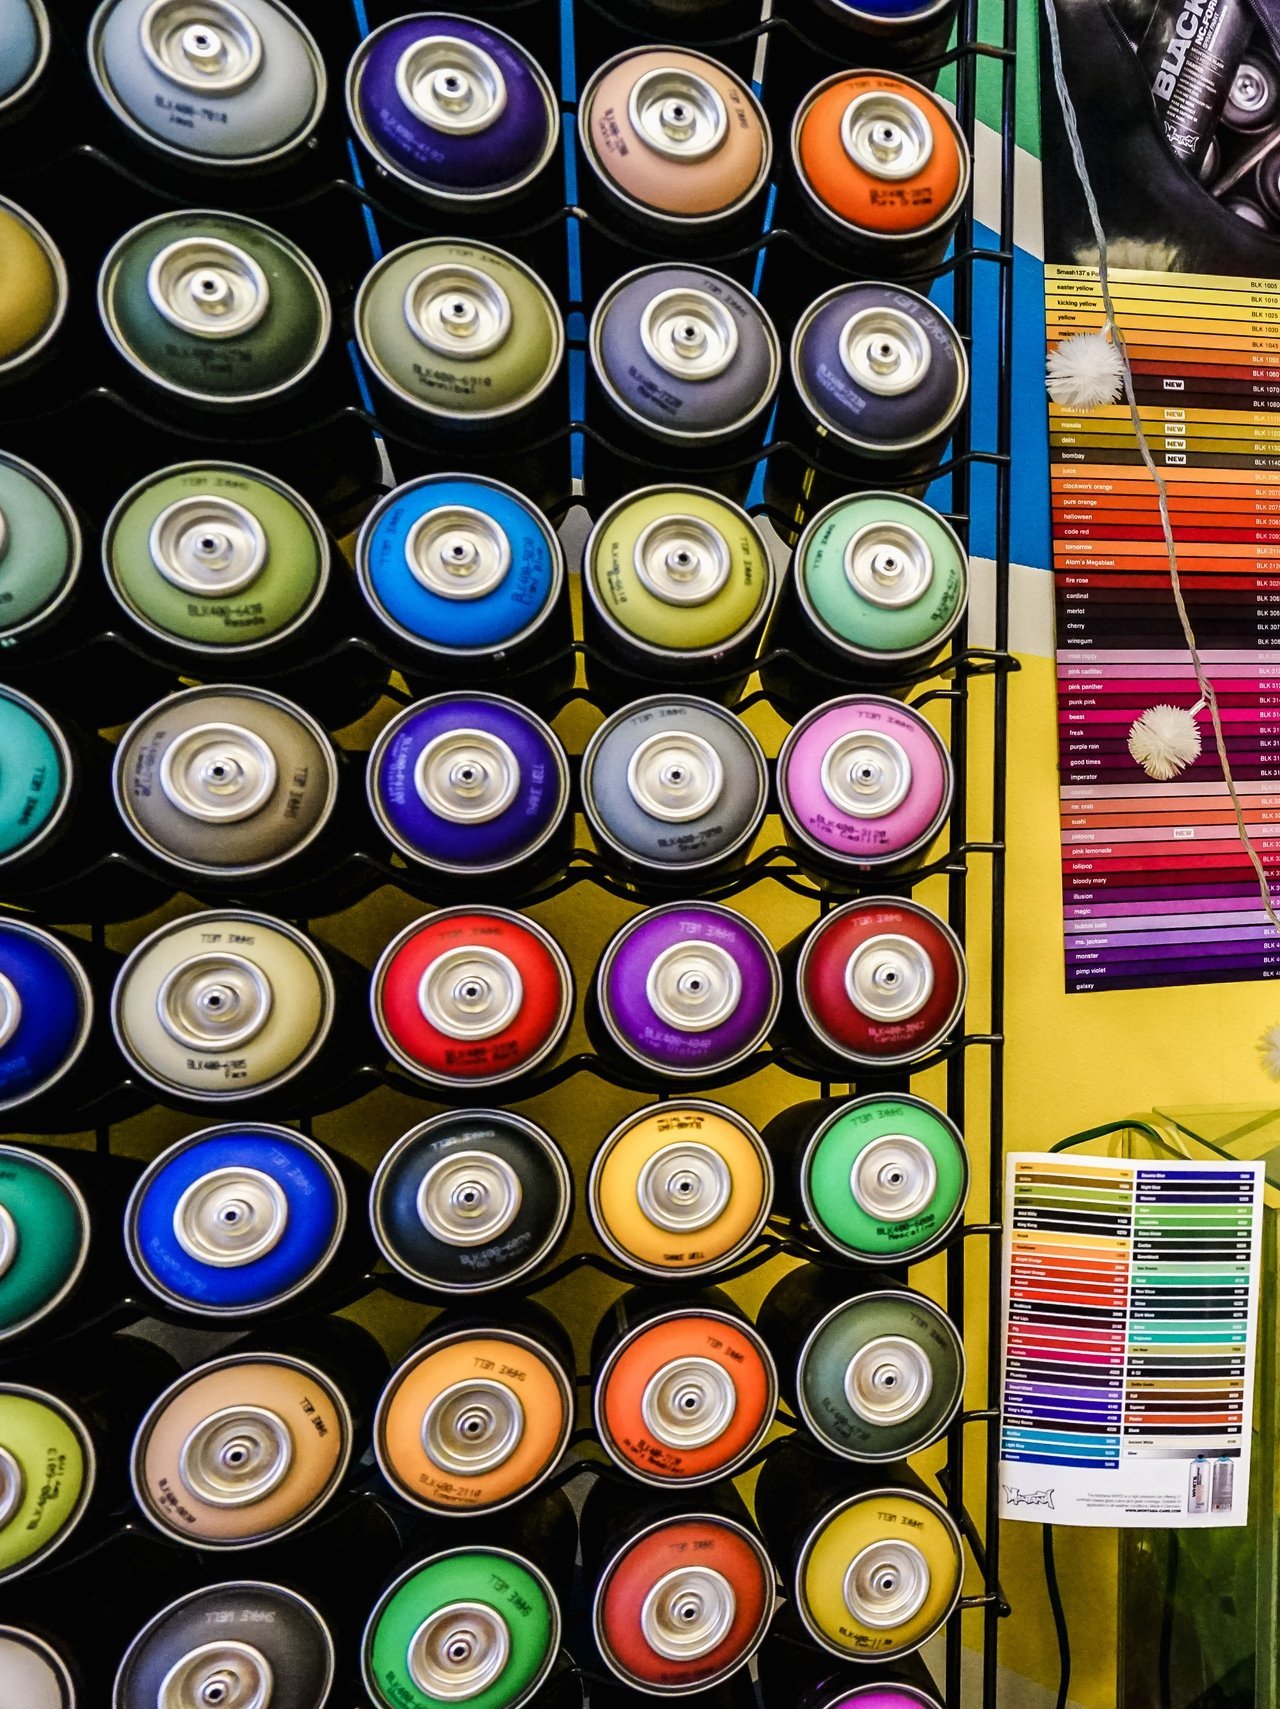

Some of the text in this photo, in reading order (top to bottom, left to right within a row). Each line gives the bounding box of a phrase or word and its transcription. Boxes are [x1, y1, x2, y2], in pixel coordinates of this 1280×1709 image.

[1076, 285, 1094, 293] yellow
[1250, 281, 1263, 289] BLK
[1057, 300, 1078, 308] kicking
[1165, 381, 1183, 389] NEW
[1061, 452, 1085, 460] bombay
[1062, 483, 1113, 492] clockwork orange
[1063, 513, 1093, 521] halloween
[1072, 862, 1093, 871] lollipop
[1072, 877, 1107, 886] bloody mary
[1076, 982, 1094, 991] galaxy
